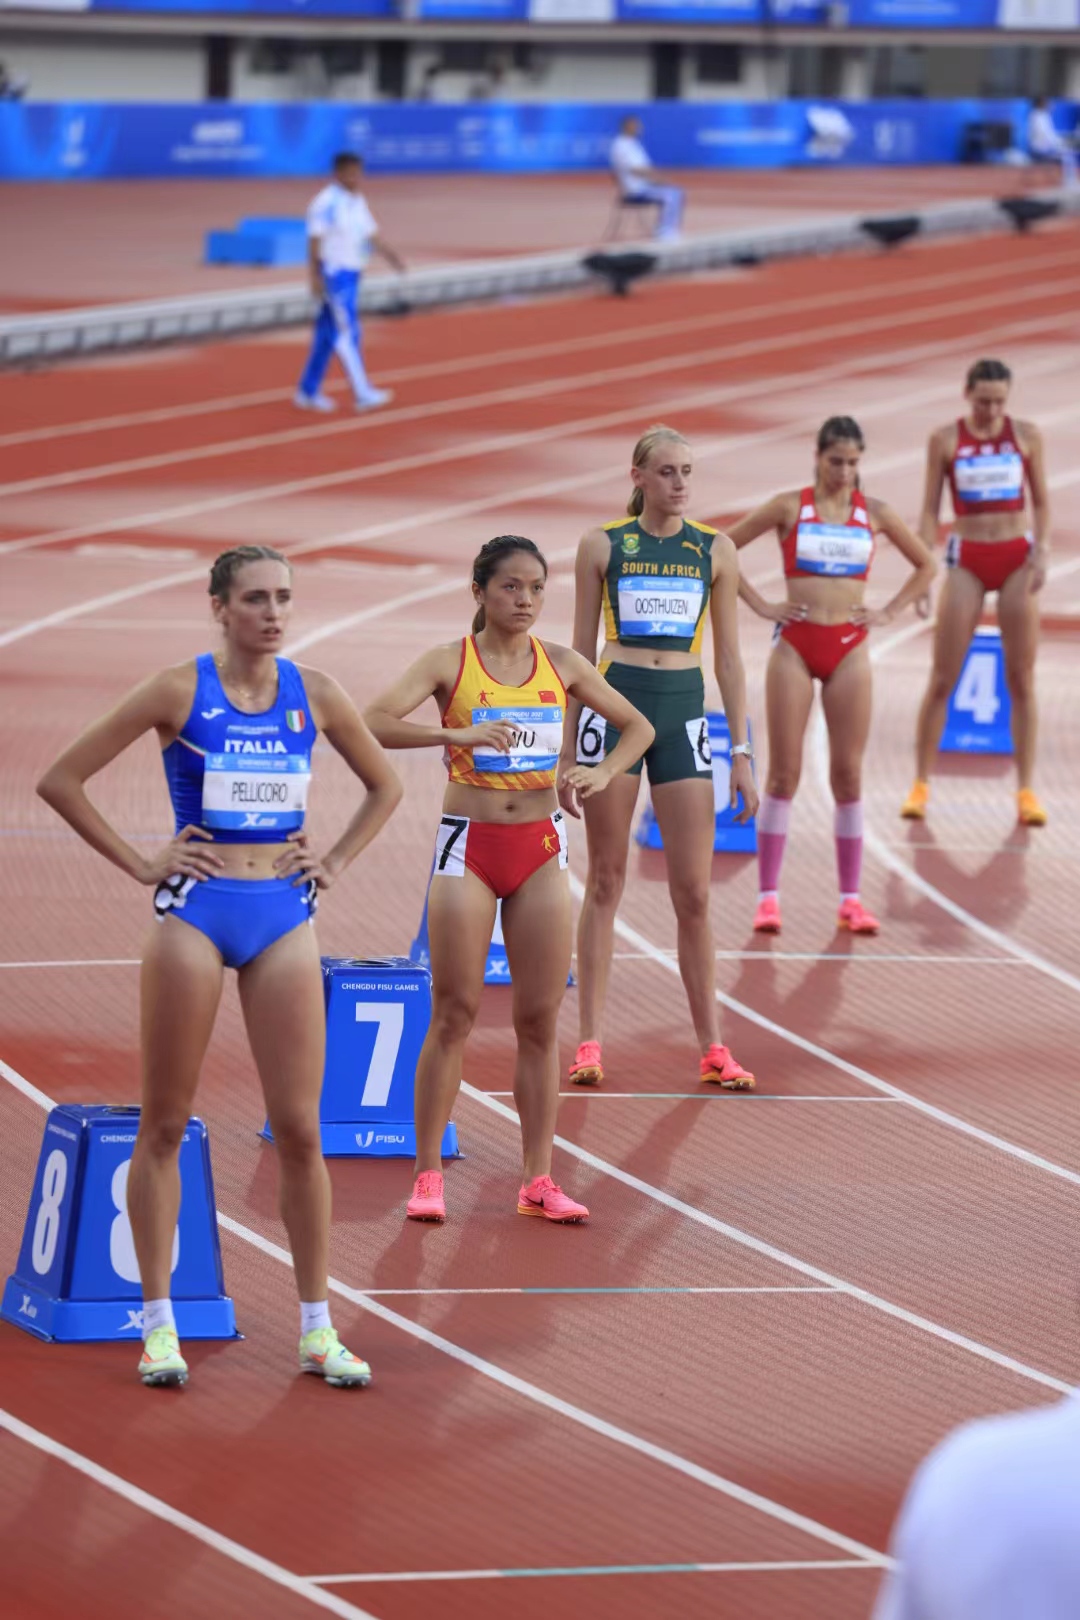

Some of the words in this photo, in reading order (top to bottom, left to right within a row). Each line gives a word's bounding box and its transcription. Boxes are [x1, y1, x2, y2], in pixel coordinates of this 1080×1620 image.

[622, 562, 658, 575] SOUTH
[662, 564, 702, 579] AFRICA
[635, 597, 689, 615] OOSTHUIZEN
[954, 652, 1001, 724] 4
[580, 712, 604, 757] 6
[224, 739, 288, 754] ITALIA
[231, 781, 289, 803] PELLICORO
[438, 818, 467, 870] 7
[341, 983, 376, 991] CHENGDU
[377, 983, 393, 991] FISU
[394, 983, 420, 991] GAMES
[355, 1002, 405, 1107] 7
[375, 1134, 405, 1144] FISU
[32, 1149, 68, 1275] 8
